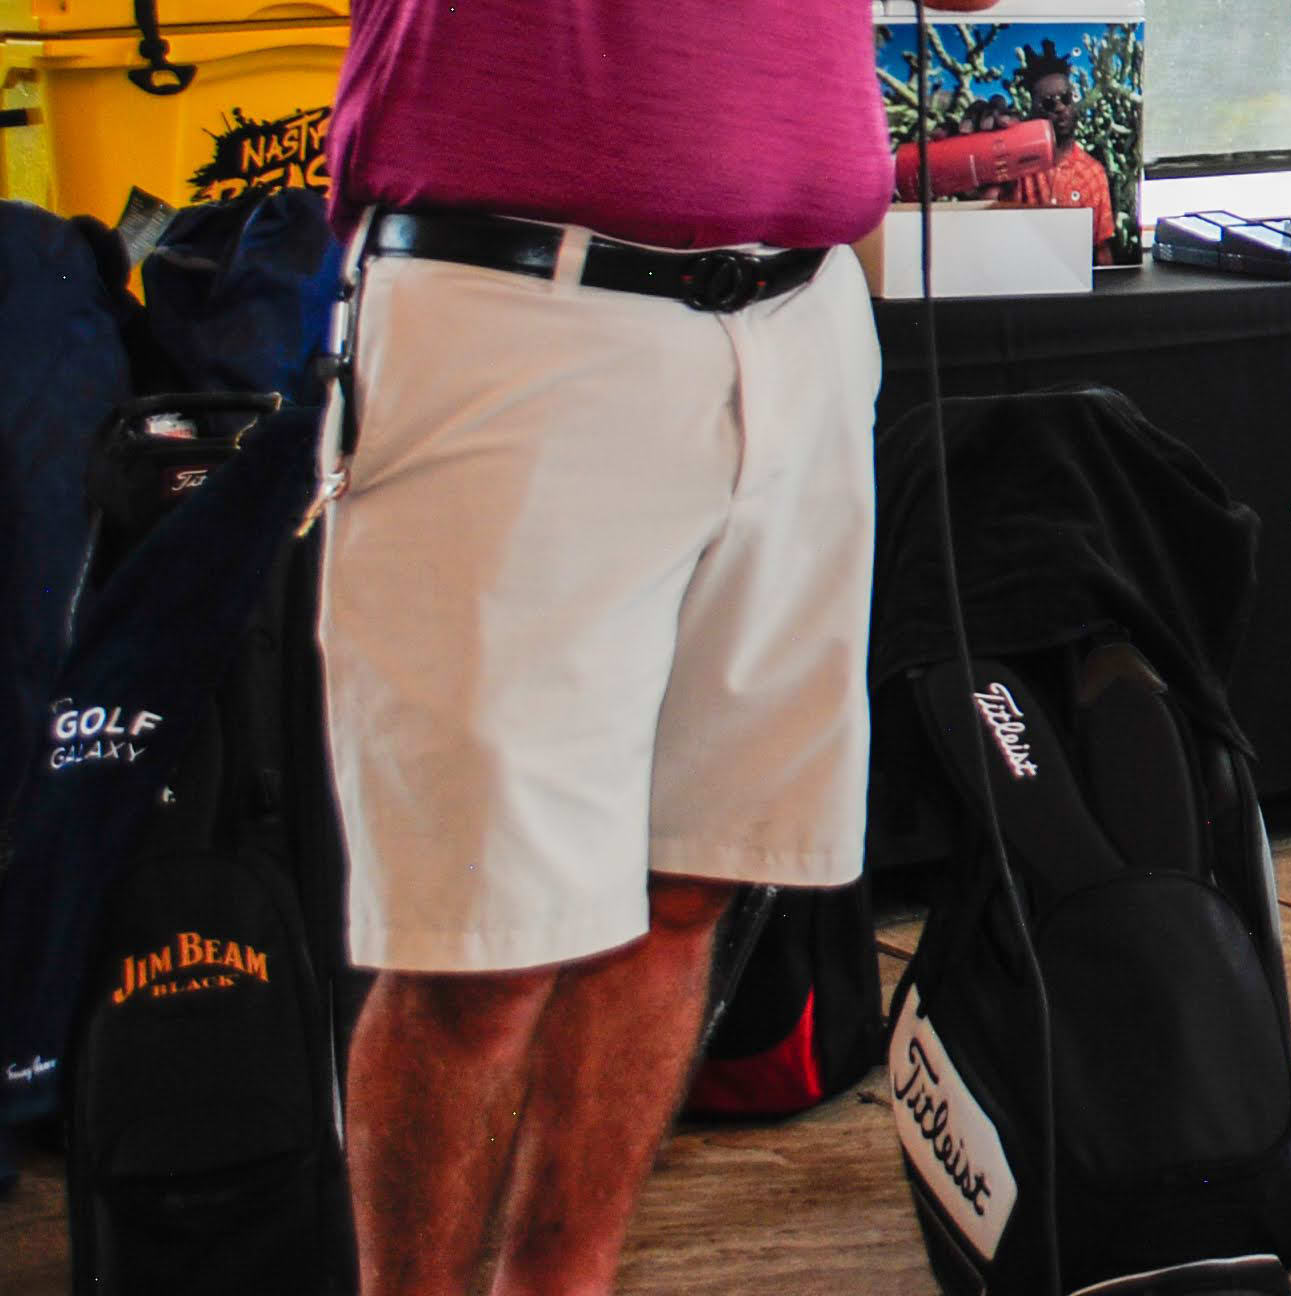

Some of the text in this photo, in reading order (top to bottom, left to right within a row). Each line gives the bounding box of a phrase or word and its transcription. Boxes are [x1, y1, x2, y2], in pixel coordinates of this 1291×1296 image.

[55, 706, 163, 740] GOLF
[973, 682, 1038, 777] Titleist
[50, 740, 147, 770] GALAXY
[111, 930, 269, 1004] JIM BEAM
[152, 974, 235, 997] BLACK
[894, 1036, 991, 1217] Titleist
